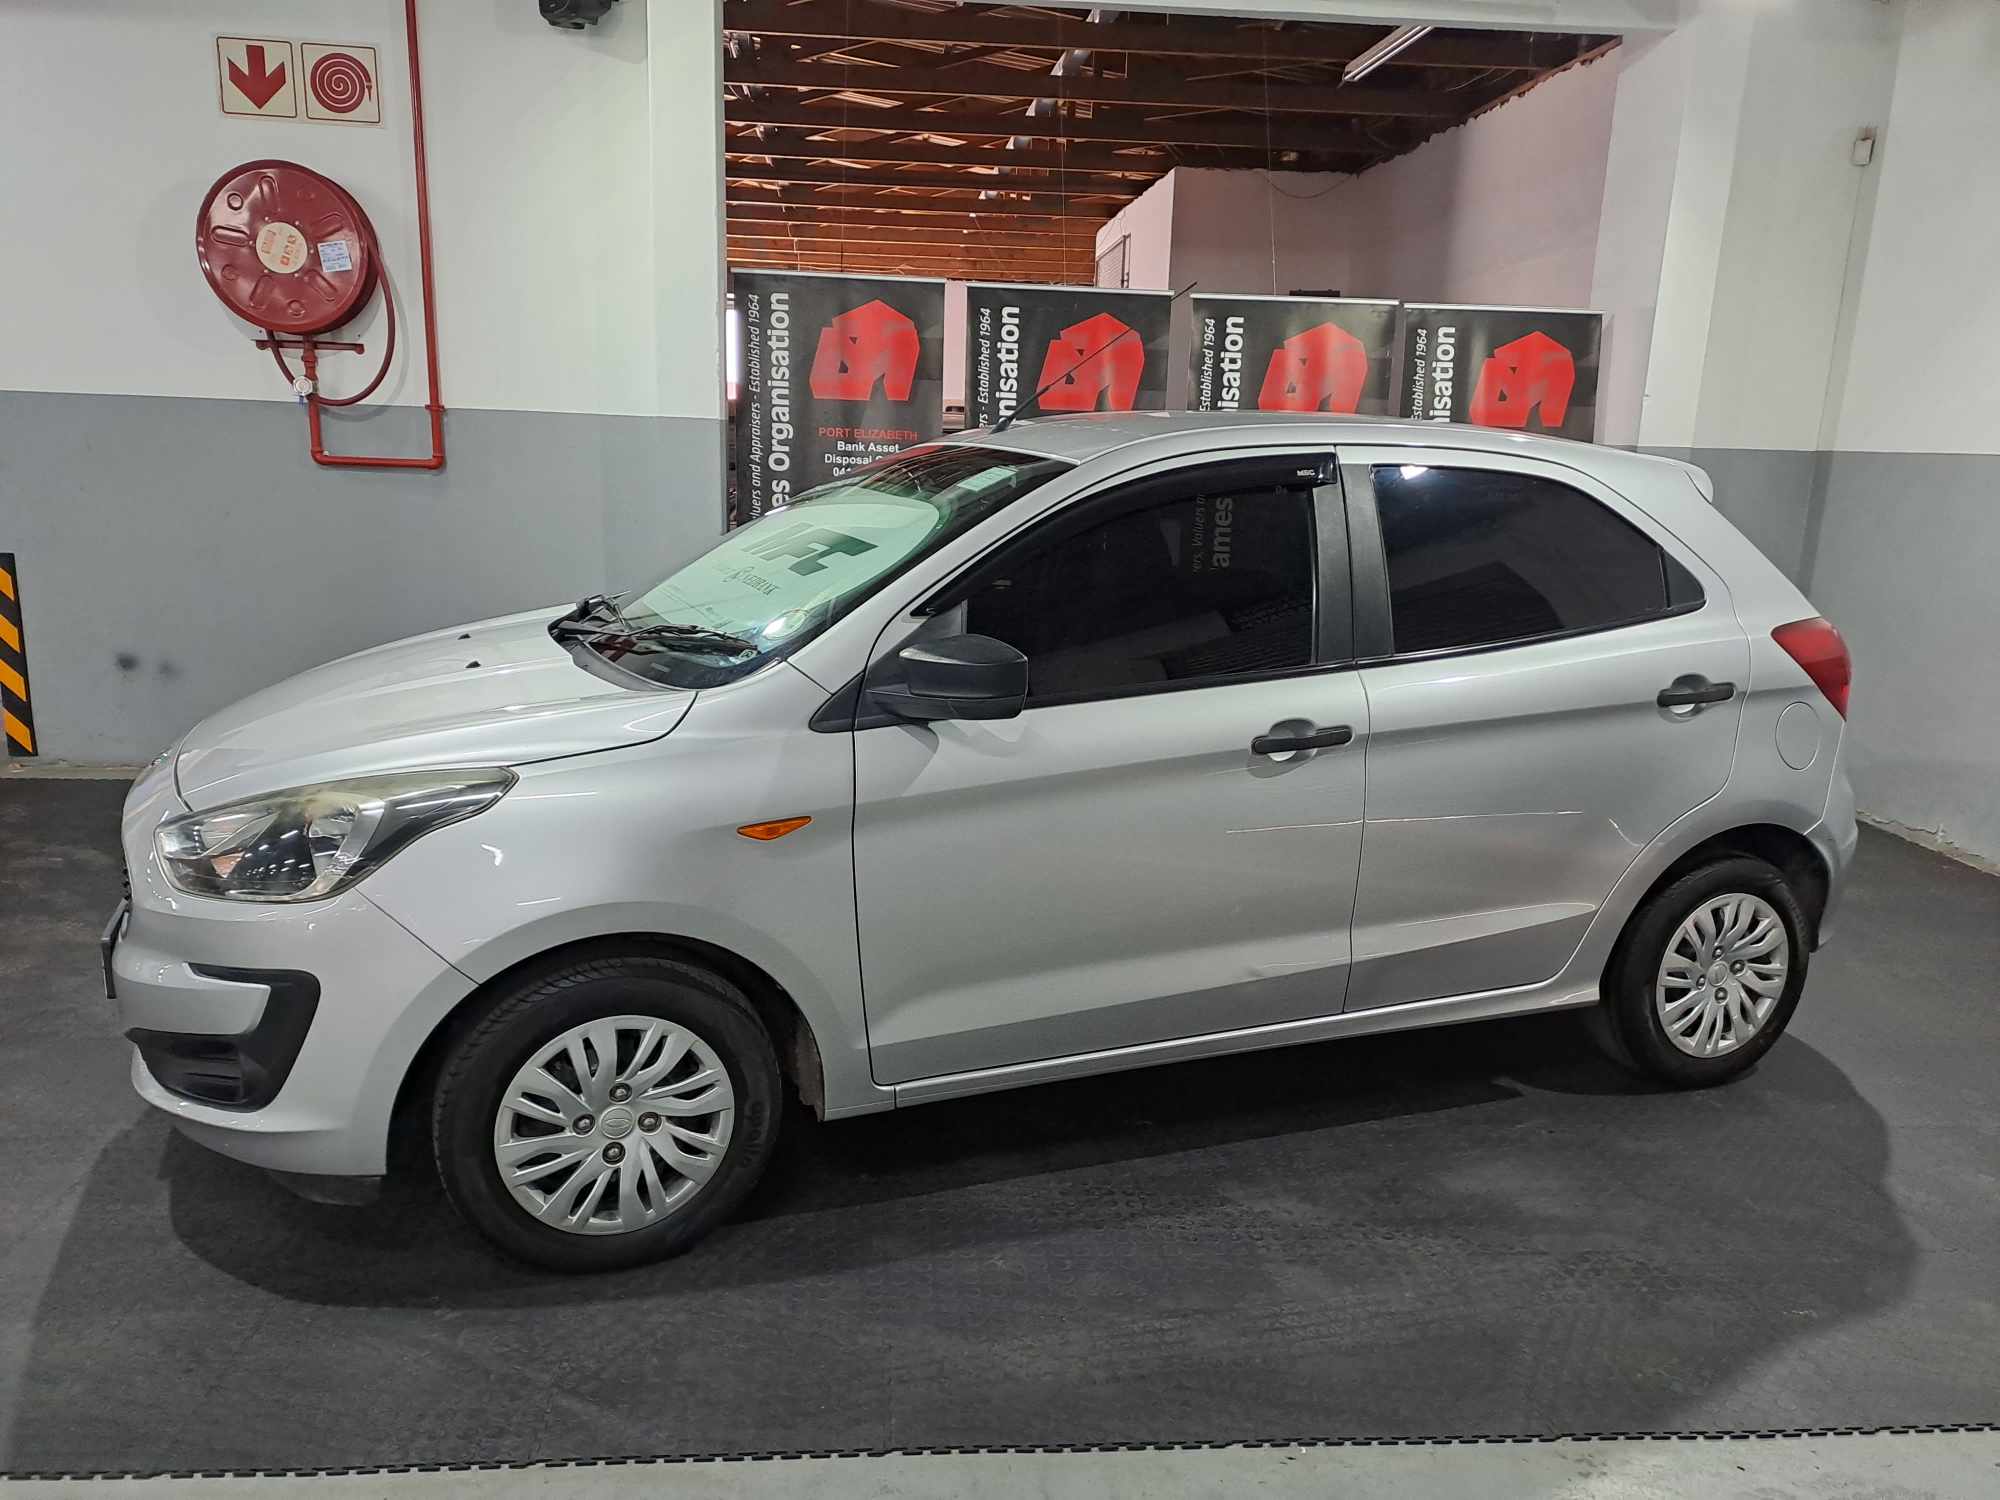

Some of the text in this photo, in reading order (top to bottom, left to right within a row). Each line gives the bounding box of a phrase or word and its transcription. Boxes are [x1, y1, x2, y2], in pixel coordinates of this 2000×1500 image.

[748, 293, 761, 322] 1964
[979, 307, 992, 336] 1964
[1203, 317, 1216, 346] 1964
[1415, 328, 1428, 356] 1964
[748, 325, 761, 393] Established
[977, 338, 991, 404] Established
[995, 306, 1020, 424] nisation
[1217, 316, 1245, 412] isation
[767, 292, 794, 472] Organisation
[749, 402, 764, 463] Appraisers
[818, 427, 919, 441] PORT ELIZABETH
[837, 441, 900, 453] Bank Asset
[824, 453, 873, 466] Disposal
[749, 464, 761, 486] and
[749, 489, 761, 518] luers
